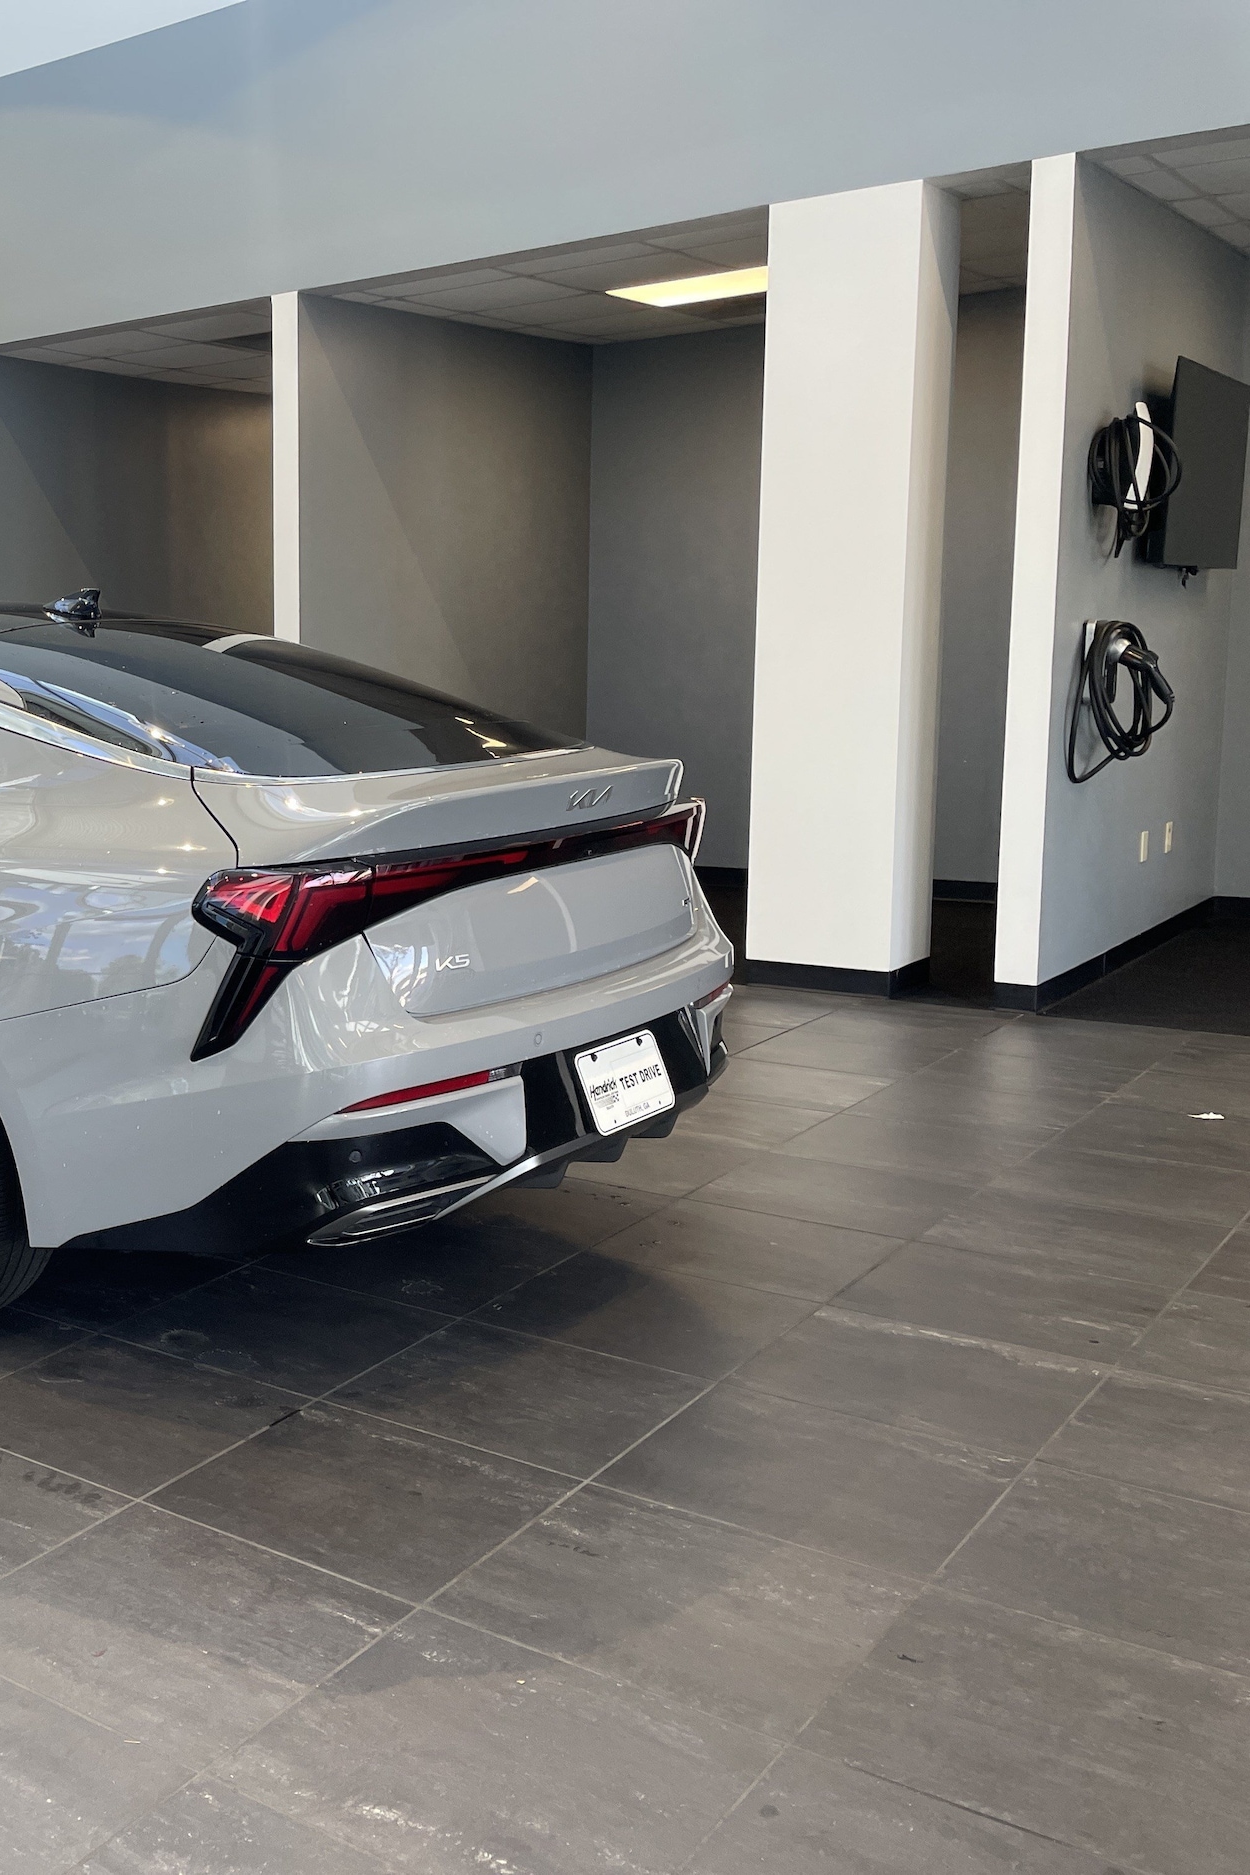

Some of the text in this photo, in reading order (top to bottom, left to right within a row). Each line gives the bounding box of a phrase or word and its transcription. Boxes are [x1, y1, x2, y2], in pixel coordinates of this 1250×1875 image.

[435, 953, 471, 972] K5
[619, 1064, 662, 1090] TEST DRIVE
